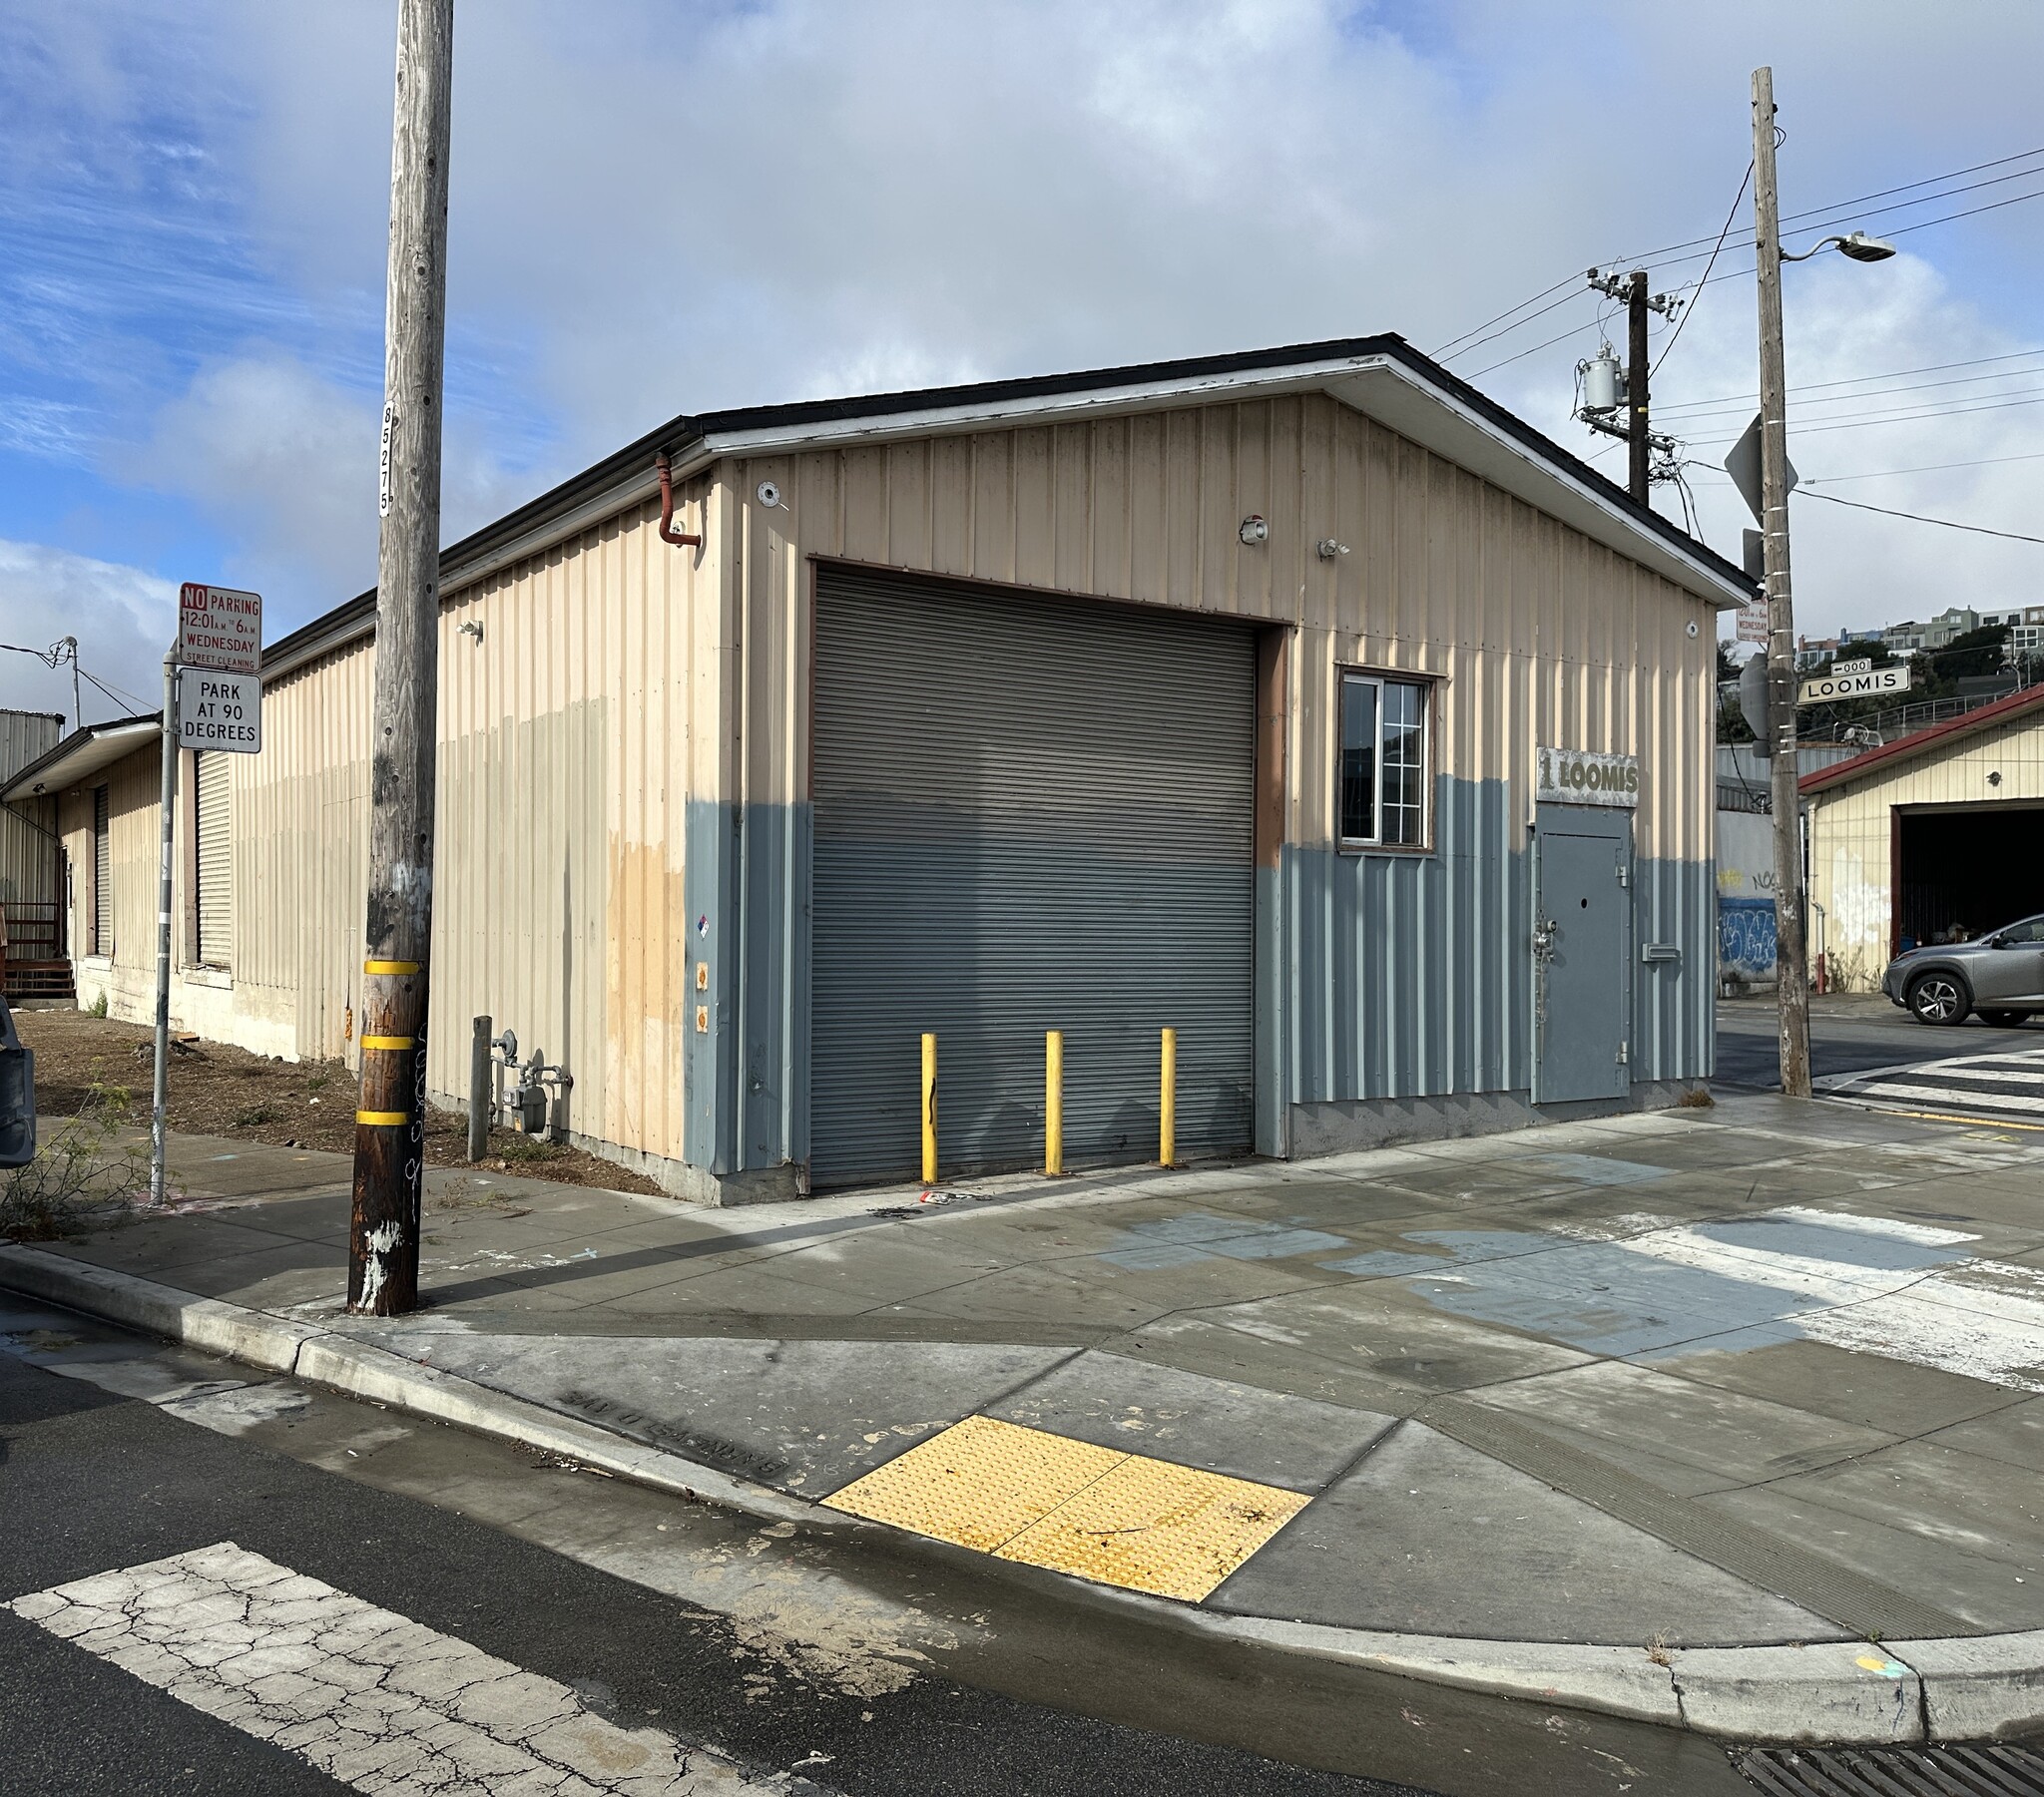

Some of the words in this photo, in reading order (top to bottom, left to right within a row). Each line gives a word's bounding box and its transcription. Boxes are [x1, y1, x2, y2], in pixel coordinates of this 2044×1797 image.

[381, 407, 391, 510] 85275
[185, 587, 206, 609] NO
[211, 595, 258, 616] PARKING
[187, 633, 255, 654] WEDNESDAY
[187, 652, 215, 664] STREET
[218, 656, 255, 669] CLEANING
[1843, 662, 1865, 673] 000
[202, 681, 240, 700] PARK
[1807, 674, 1896, 697] LOOMIS
[198, 701, 216, 717] AT
[223, 703, 243, 720] 90
[186, 720, 256, 741] DEGREES
[1539, 756, 1554, 789] 1
[1560, 760, 1638, 794] LOOMIS
